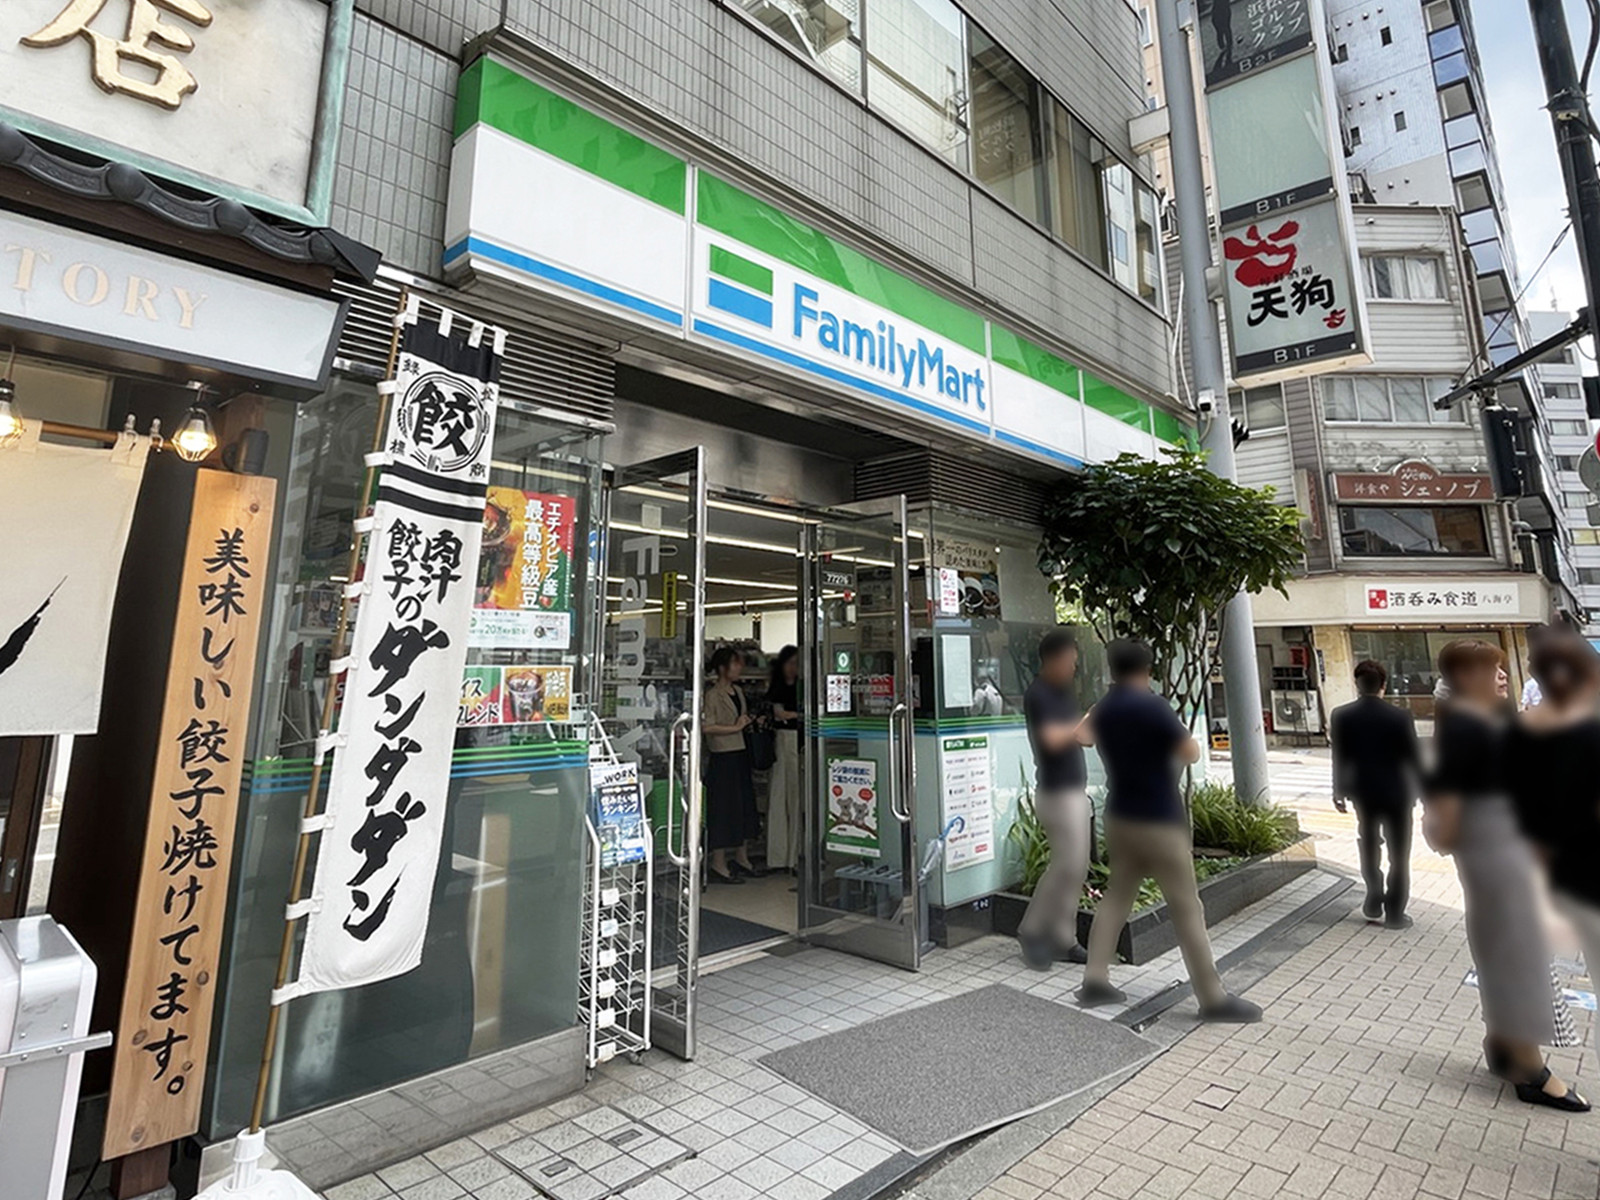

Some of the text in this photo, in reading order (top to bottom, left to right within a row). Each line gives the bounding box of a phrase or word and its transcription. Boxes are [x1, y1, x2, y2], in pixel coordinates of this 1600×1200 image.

[1240, 49, 1278, 73] B2F
[1256, 193, 1296, 215] B1F
[4, 242, 207, 330] TORY
[1247, 274, 1335, 327] 天狗
[793, 282, 987, 412] FamilyMart
[1274, 344, 1316, 364] B1F
[410, 380, 478, 457] 餃
[1400, 480, 1482, 498] シェ・ノブ
[382, 517, 423, 623] 餃子の
[418, 528, 464, 604] 肉汁
[541, 501, 563, 597] エチオピア産
[1389, 590, 1479, 608] 酒呑み食道
[142, 527, 252, 1096] 美味しい餃子焼けてます。
[341, 618, 452, 943] ダンダダン
